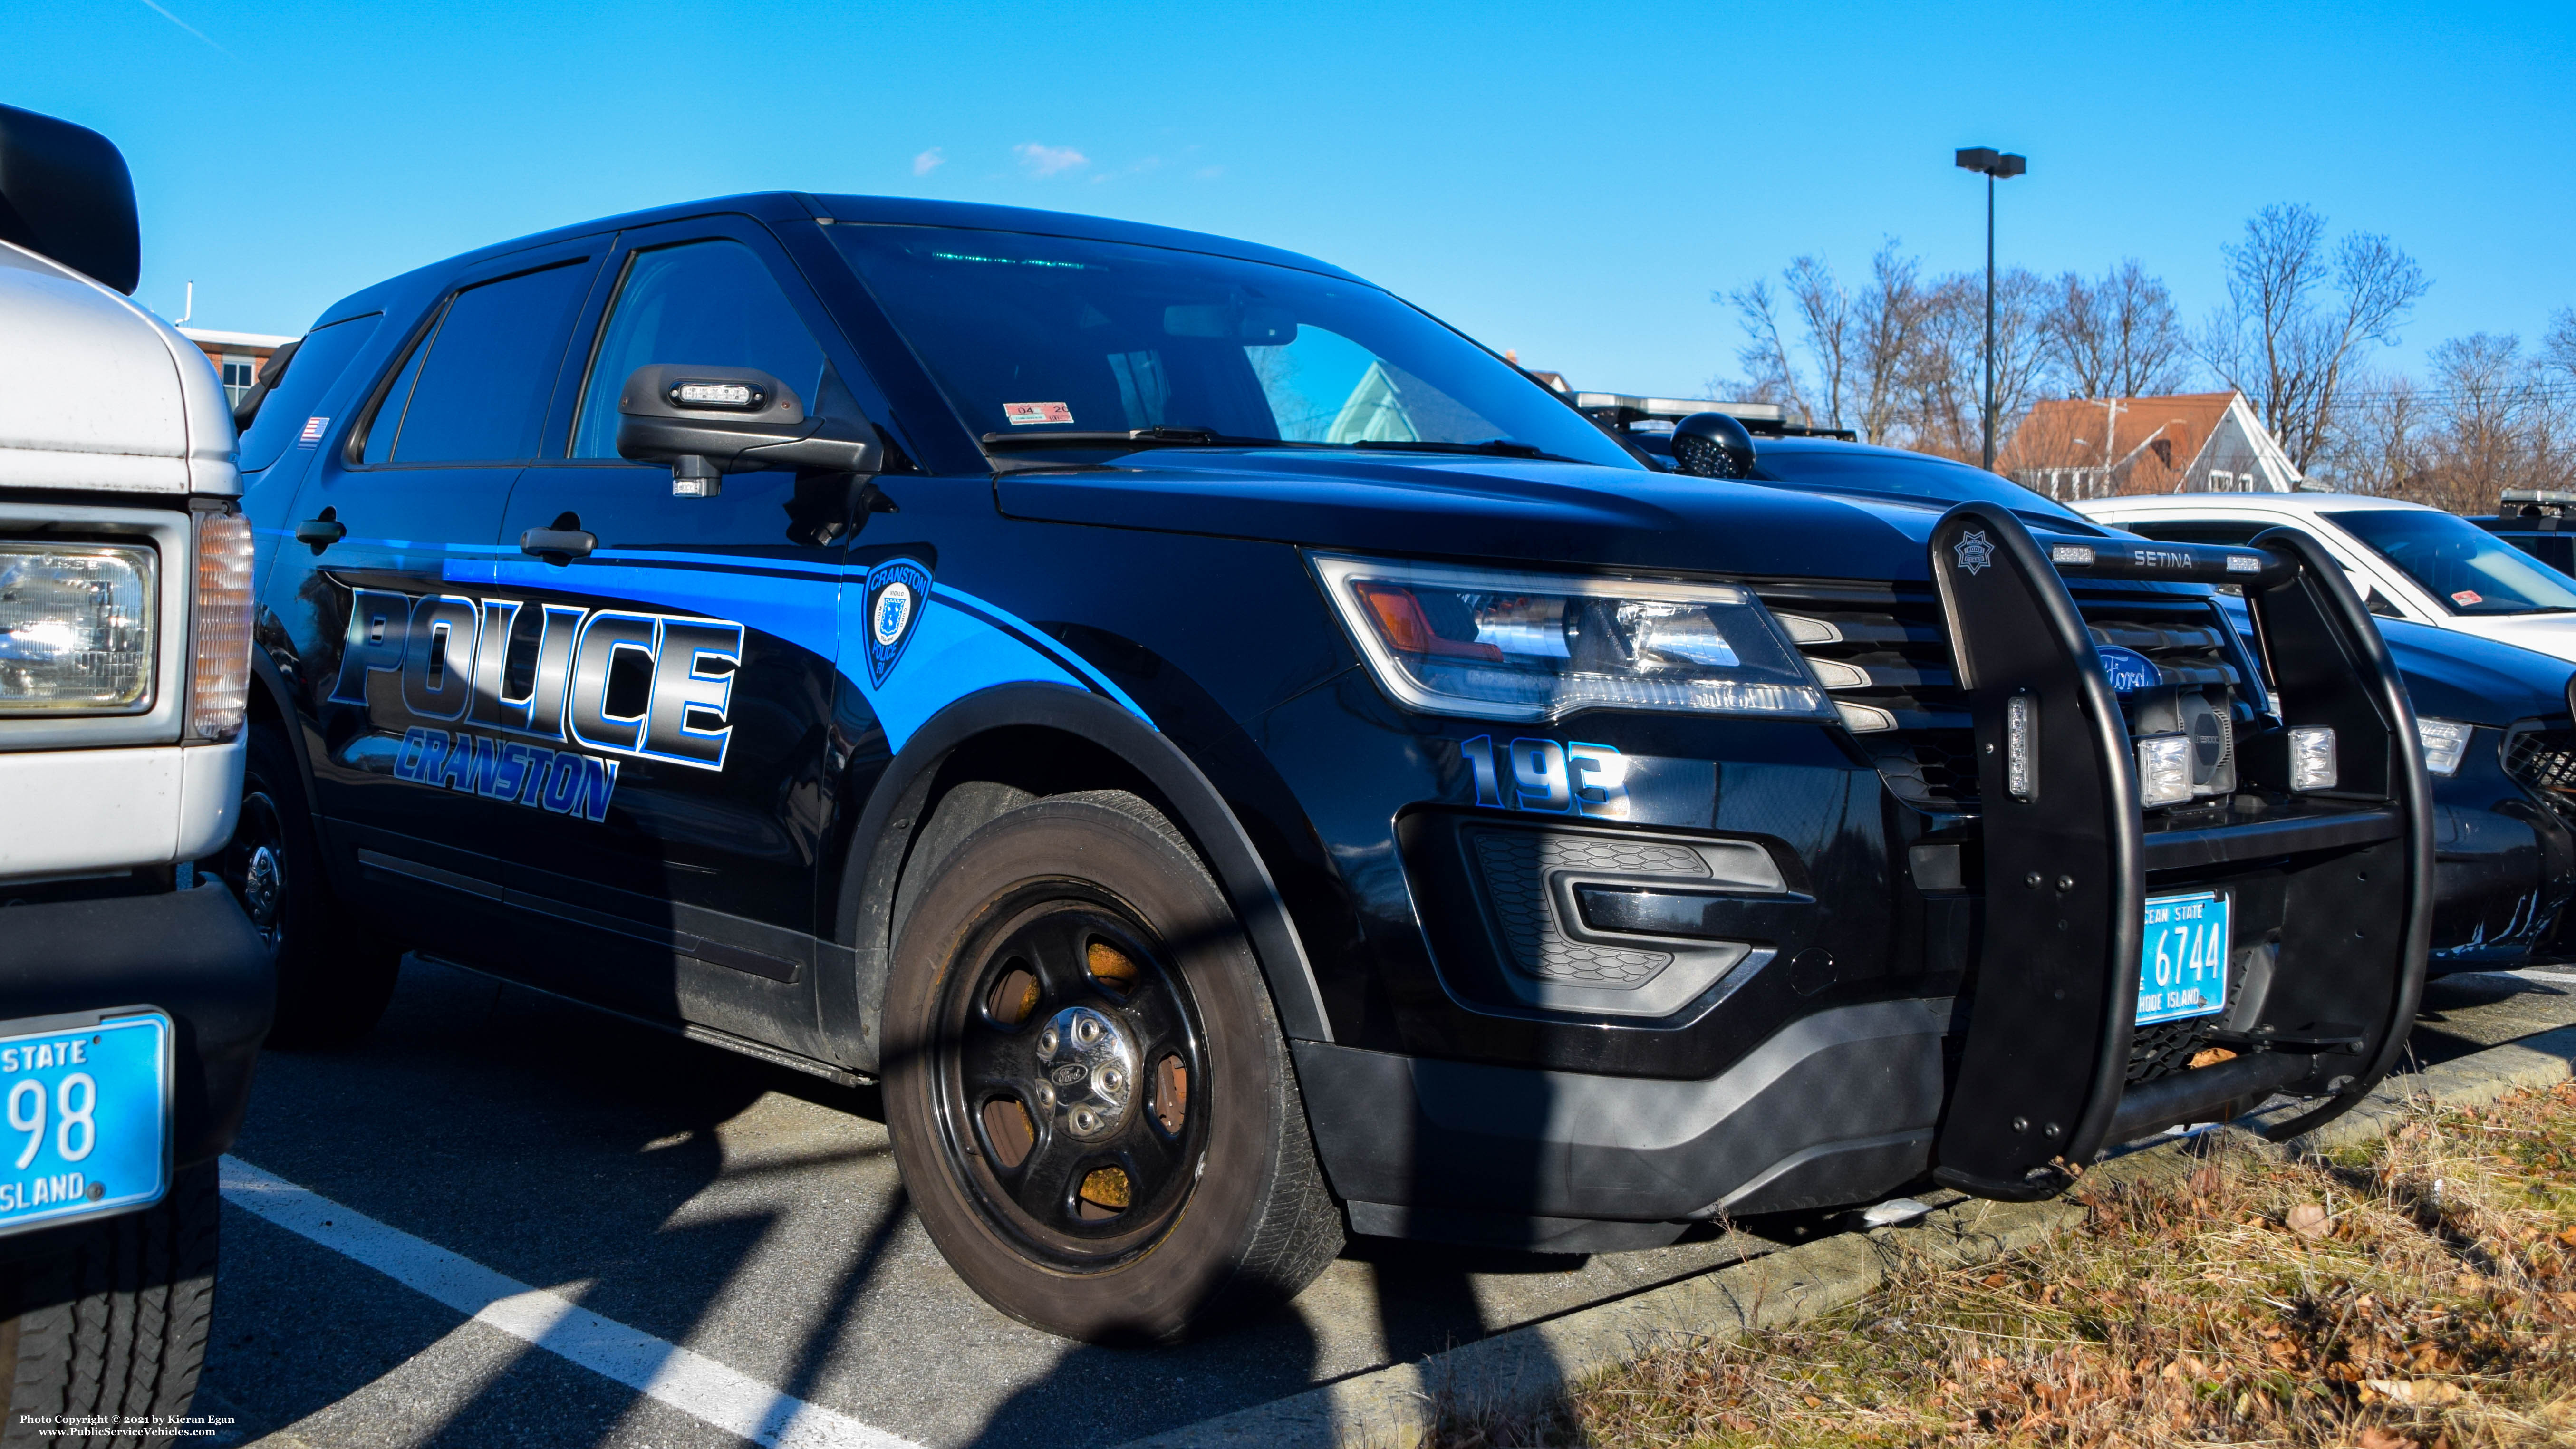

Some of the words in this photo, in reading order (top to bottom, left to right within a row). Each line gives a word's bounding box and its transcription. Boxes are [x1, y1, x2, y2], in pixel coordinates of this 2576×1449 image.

[2134, 551, 2192, 568] SETINA
[871, 567, 926, 596] CRANSTON
[872, 639, 898, 661] POLICE
[328, 587, 744, 771] POLICE
[877, 662, 885, 674] RI
[2101, 655, 2146, 690] Ford
[394, 725, 620, 822] CRANSTON
[1461, 734, 1631, 820] 193
[2175, 904, 2203, 921] STATE
[2155, 923, 2219, 987] 6744
[2167, 988, 2199, 1008] ISLAND
[1, 1040, 87, 1073] STATE
[1059, 1067, 1080, 1083] Ford
[7, 1072, 96, 1170] 98
